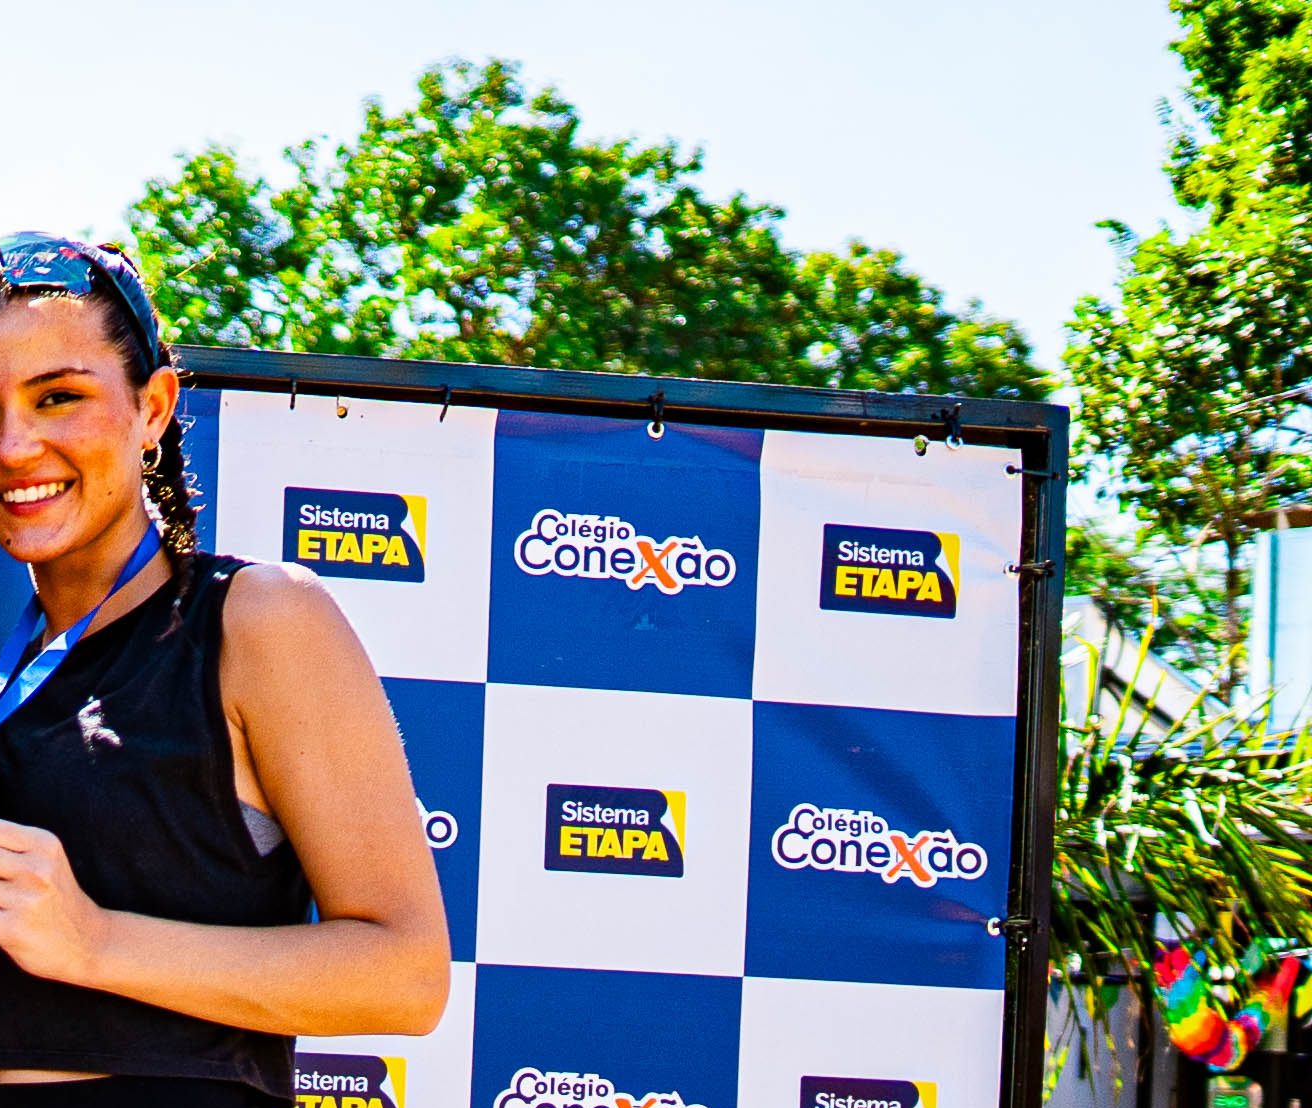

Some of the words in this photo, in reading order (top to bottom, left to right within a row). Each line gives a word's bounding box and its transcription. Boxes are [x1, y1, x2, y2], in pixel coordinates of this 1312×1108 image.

[300, 505, 390, 530] Sistema
[537, 514, 631, 544] Colégio
[295, 529, 409, 566] ETAPA
[837, 542, 924, 566] Sistema
[833, 565, 943, 602] ETAPA
[562, 801, 650, 826] Sistema
[793, 808, 885, 838] Colégio
[558, 825, 668, 862] ETAPA
[294, 1069, 368, 1092] istema
[516, 1072, 610, 1101] Colégio
